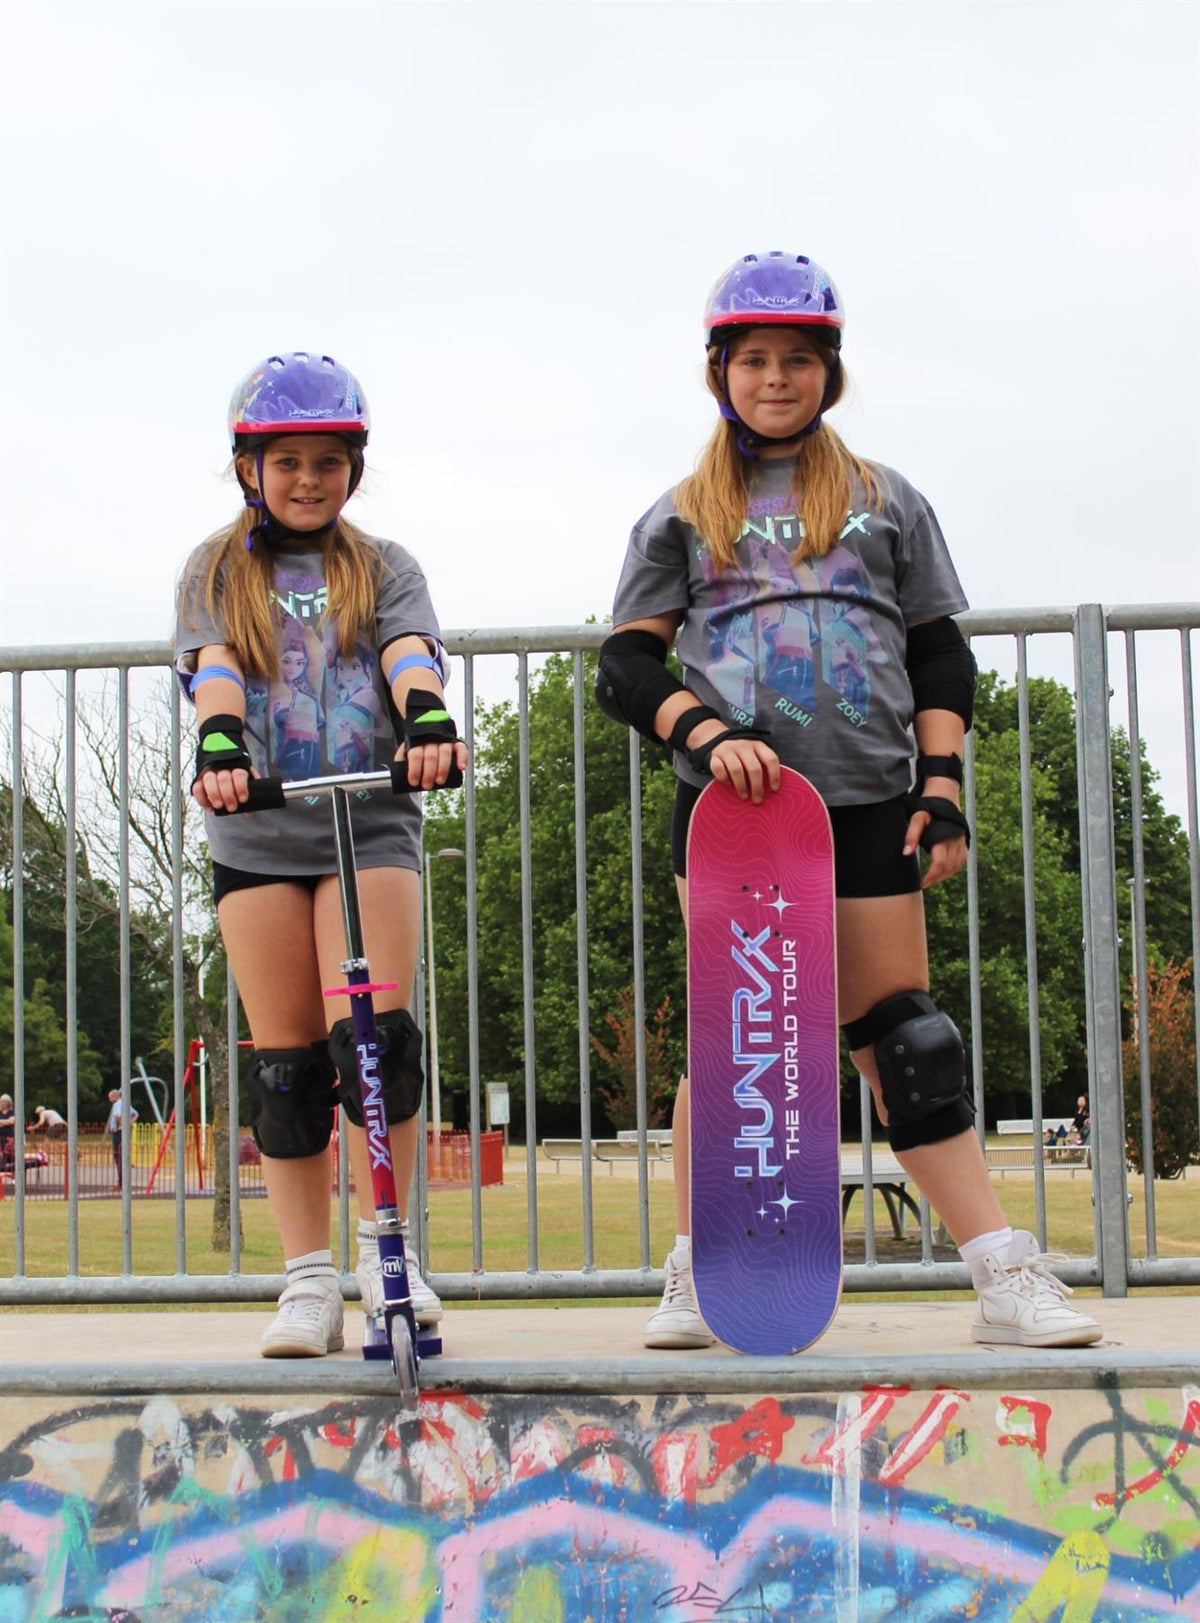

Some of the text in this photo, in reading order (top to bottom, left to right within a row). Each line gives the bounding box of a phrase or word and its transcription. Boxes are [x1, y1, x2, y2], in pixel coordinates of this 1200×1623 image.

[774, 697, 813, 728] RUMI
[835, 697, 868, 728] ZOEY
[782, 939, 801, 1160] THE WORLD TOUR
